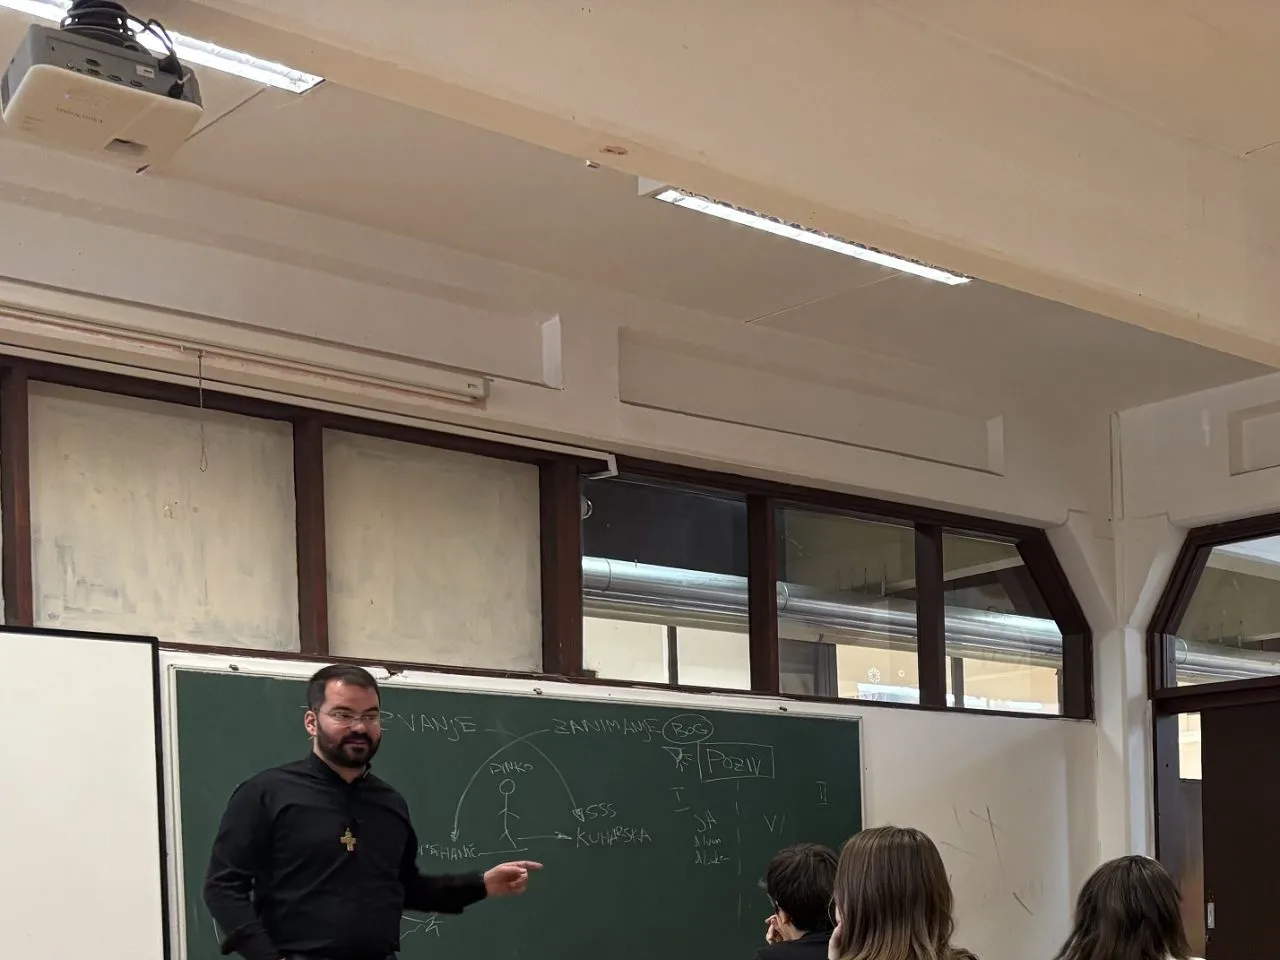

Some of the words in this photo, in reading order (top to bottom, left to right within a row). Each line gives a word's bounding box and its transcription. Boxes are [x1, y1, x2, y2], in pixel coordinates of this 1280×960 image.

[672, 723, 708, 737] BOG
[707, 749, 761, 776] POZIV
[576, 826, 652, 848] KUHARSKA
